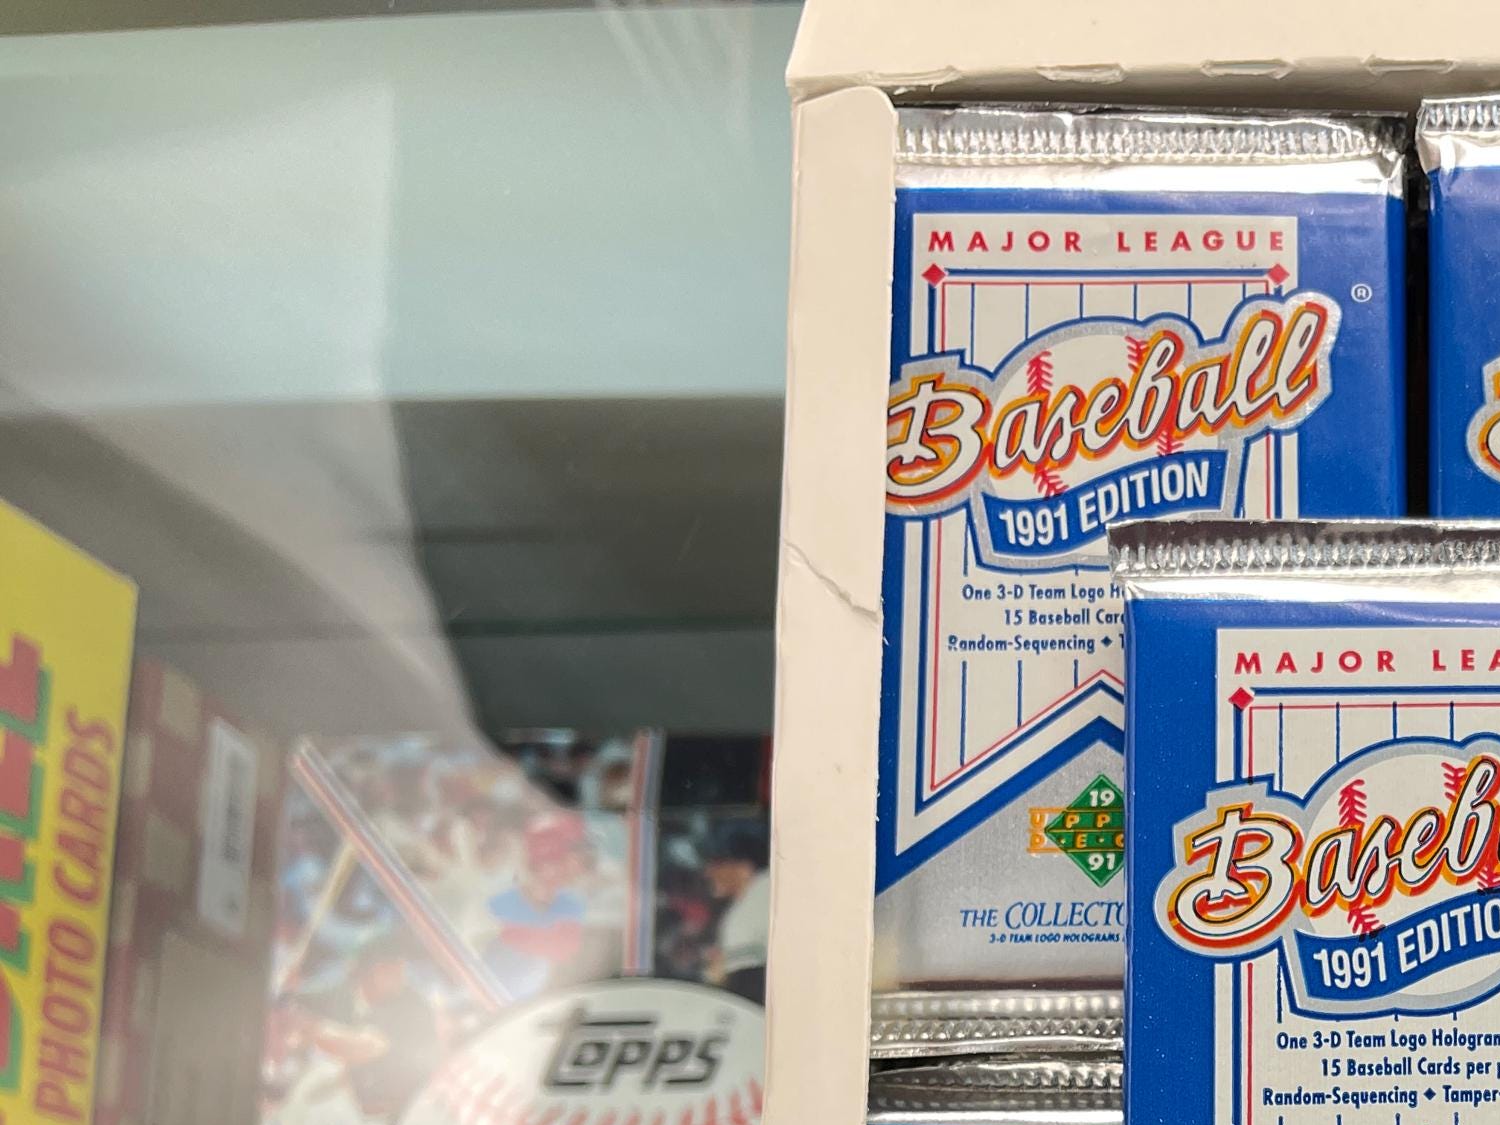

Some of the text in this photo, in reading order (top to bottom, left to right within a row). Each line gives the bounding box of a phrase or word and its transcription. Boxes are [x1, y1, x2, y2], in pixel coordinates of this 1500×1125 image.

[928, 230, 1285, 252] MAJOR LEAGUE
[886, 301, 1328, 507] Baseball
[1000, 460, 1210, 545] 1991 EDITION
[962, 584, 992, 600] One
[997, 584, 1024, 600] 3-D
[1029, 584, 1066, 600] Team
[1071, 583, 1105, 602] Logo
[1005, 608, 1090, 625] 15 Baseball
[947, 634, 1095, 654] Random-Sequencing
[1234, 651, 1396, 674] MAJOR
[54, 704, 117, 907] CARDS
[1089, 789, 1115, 806] 19
[1089, 854, 1116, 871] 91
[960, 909, 998, 928] THE
[1009, 932, 1120, 943] TEAM LOGO HOLOGRAMS
[1313, 945, 1390, 989] 1991
[35, 917, 99, 1123] PHOTO
[1276, 1032, 1307, 1049] One
[1313, 1032, 1342, 1049] 3-D
[1346, 1031, 1386, 1049] Team
[1391, 1031, 1427, 1052] Logo
[1321, 1058, 1342, 1077] 15
[1347, 1057, 1413, 1076] Baseball
[1418, 1057, 1461, 1076] Cards
[1466, 1061, 1492, 1079] per
[1263, 1087, 1418, 1107] Random-Sequencing
